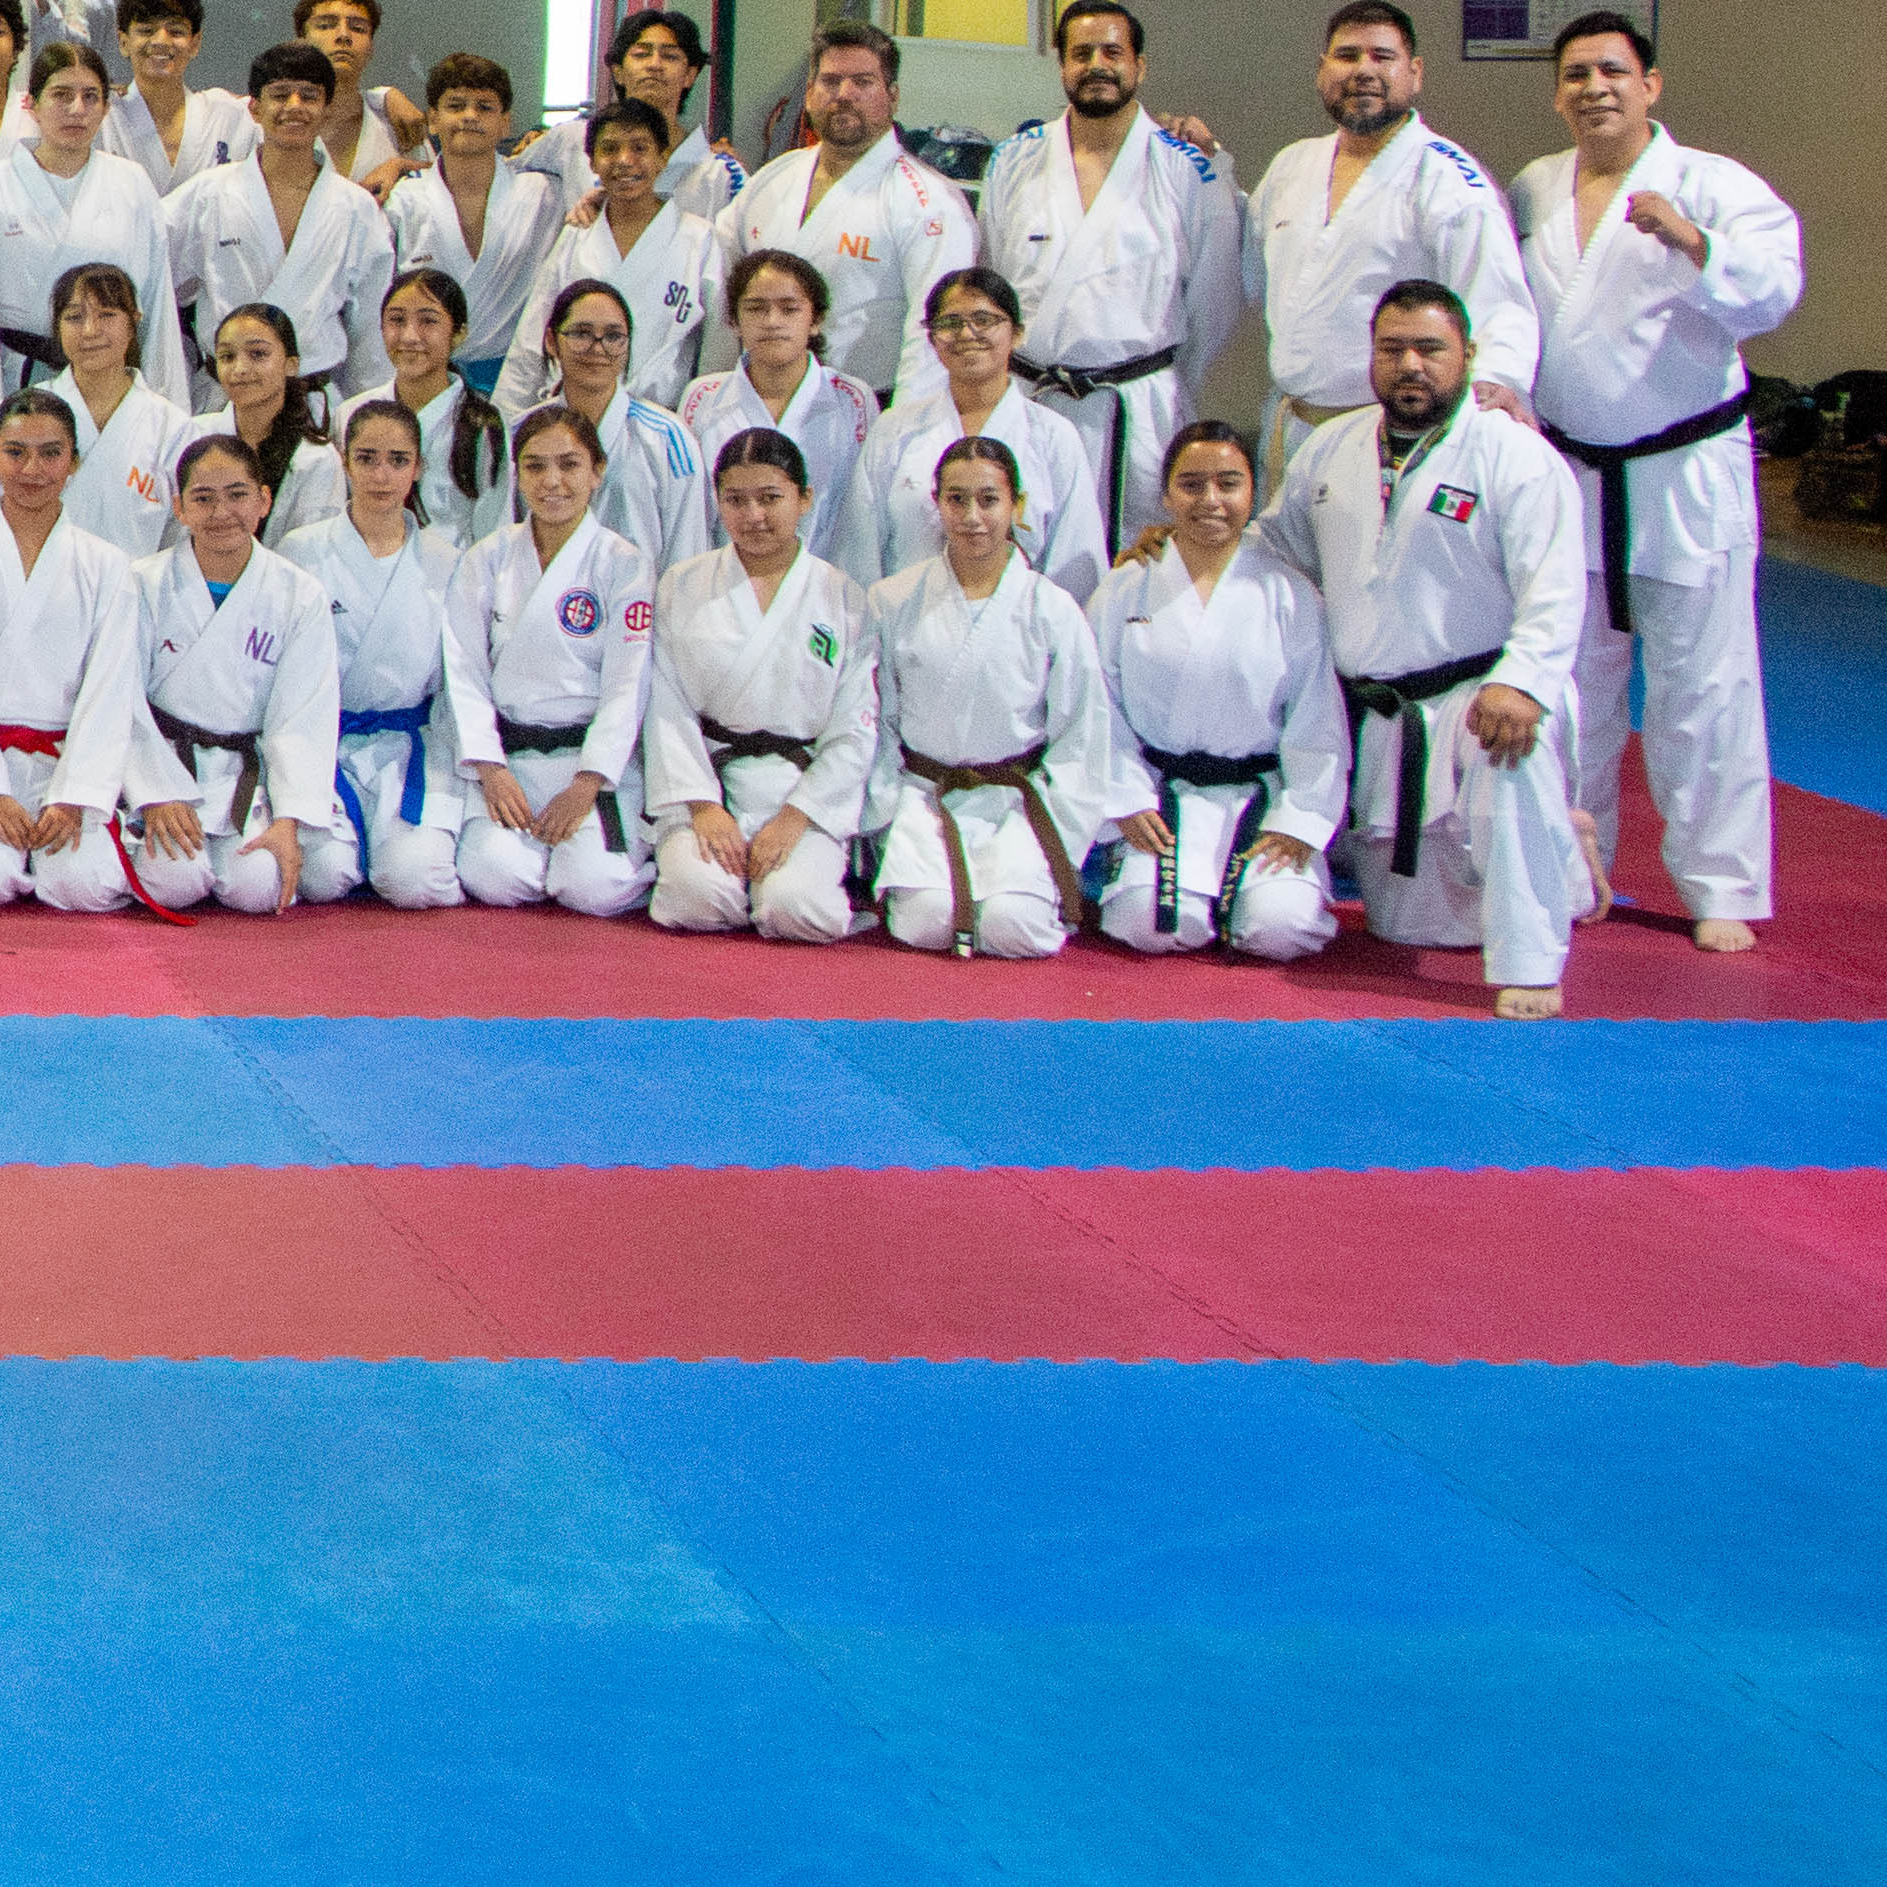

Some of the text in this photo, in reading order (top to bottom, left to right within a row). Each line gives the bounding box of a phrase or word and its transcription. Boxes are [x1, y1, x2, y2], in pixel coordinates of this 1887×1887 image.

[1426, 141, 1486, 188] SMAI
[837, 232, 882, 263] NL
[127, 466, 161, 503] NL
[245, 626, 278, 666] NL
